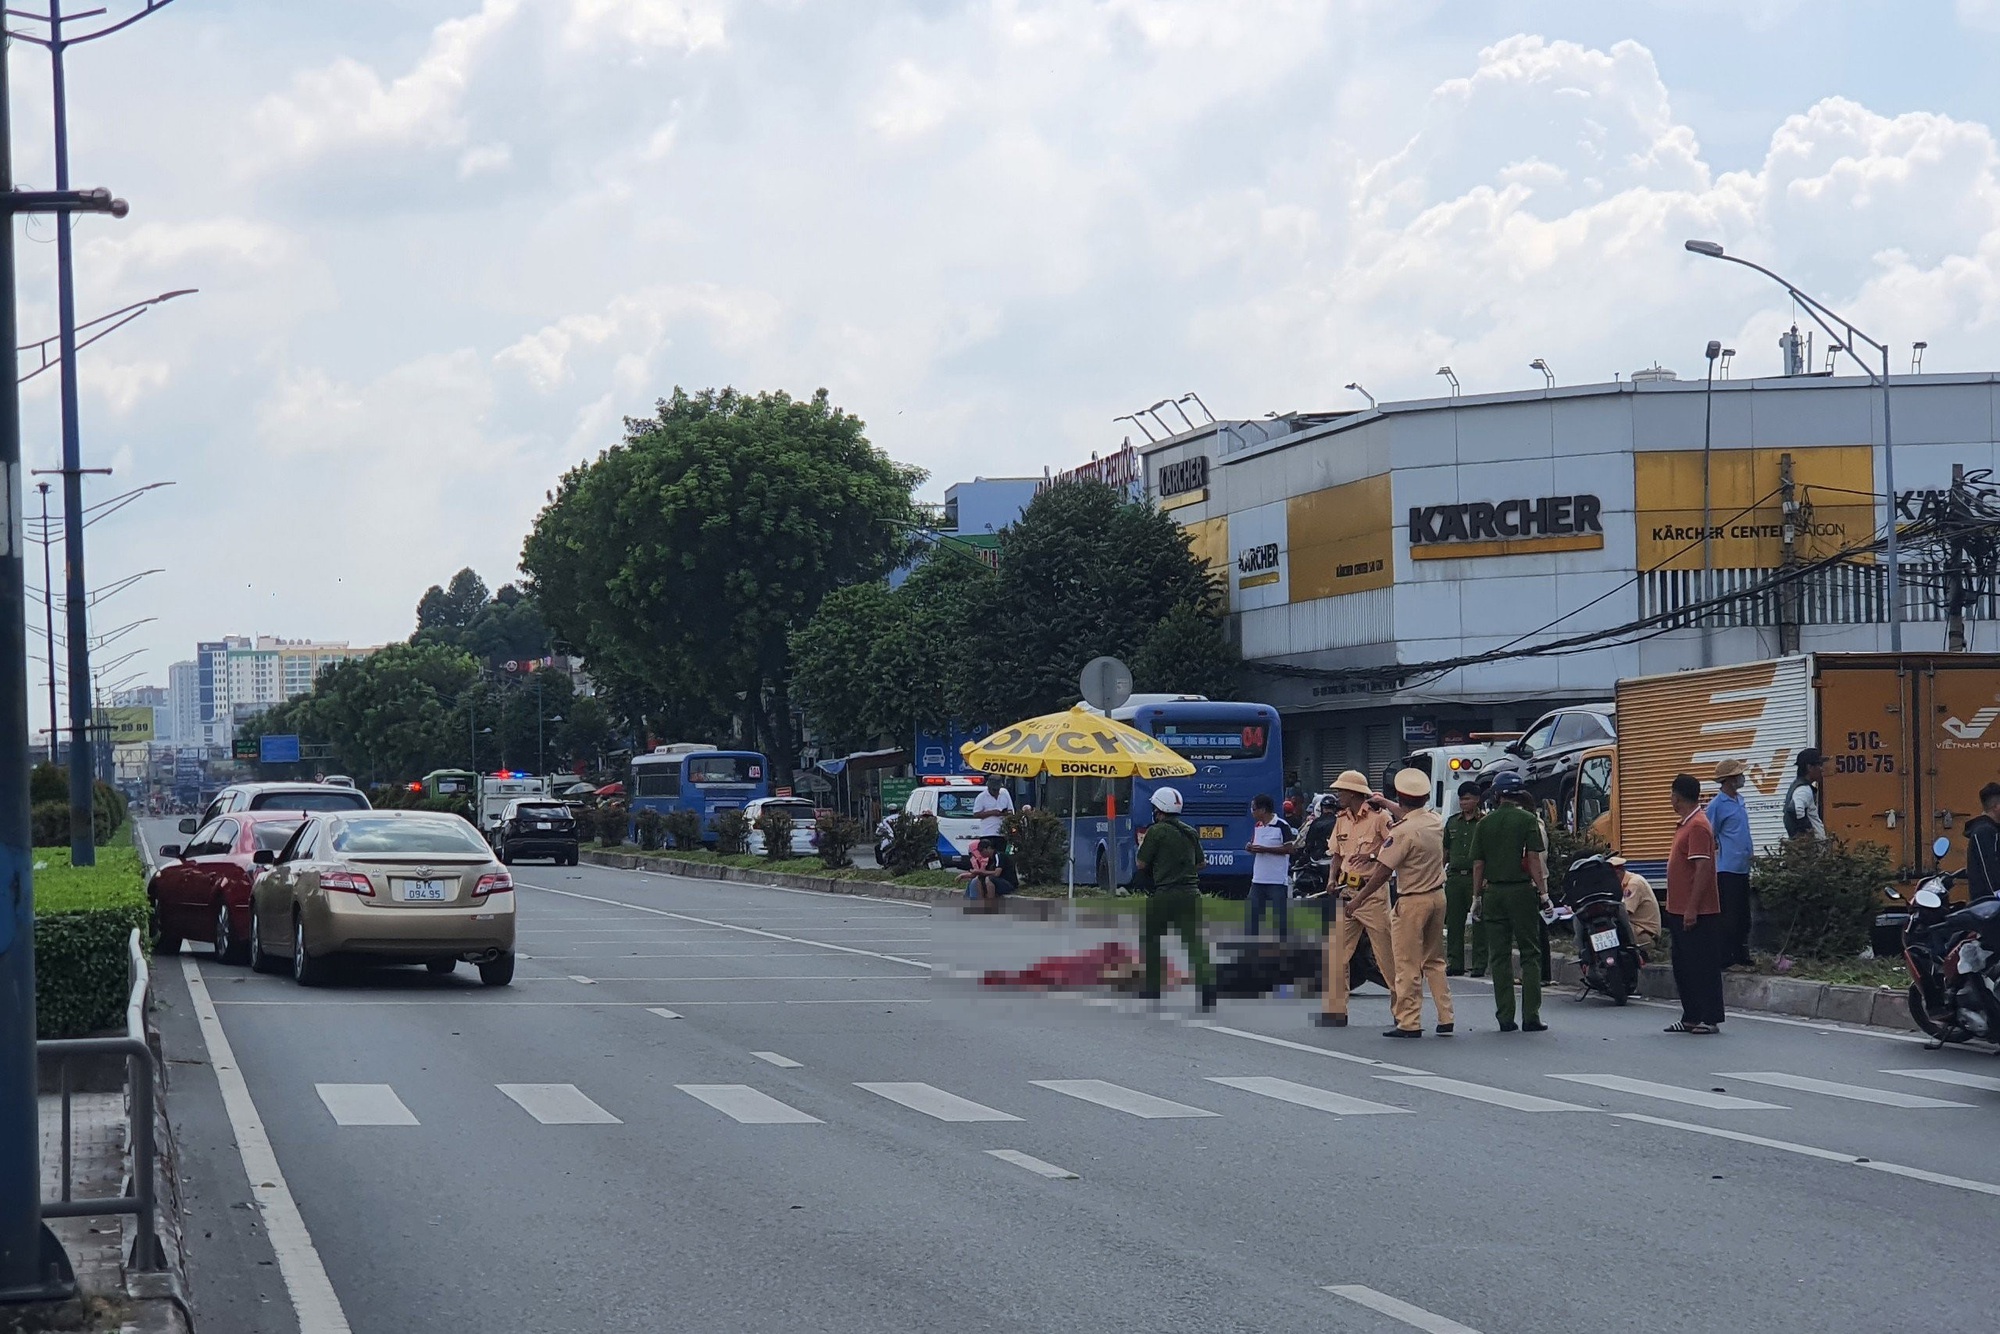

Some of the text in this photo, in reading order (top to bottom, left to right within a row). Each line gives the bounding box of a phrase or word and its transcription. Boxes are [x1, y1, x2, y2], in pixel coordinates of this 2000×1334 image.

[1409, 494, 1602, 543] KÄRCHER
[1652, 525, 1724, 541] KÄRCHER
[1848, 731, 1879, 750] 51C
[982, 762, 1029, 775] BONCHA
[1061, 764, 1118, 775] BONCHA
[1836, 755, 1893, 773] 508-75
